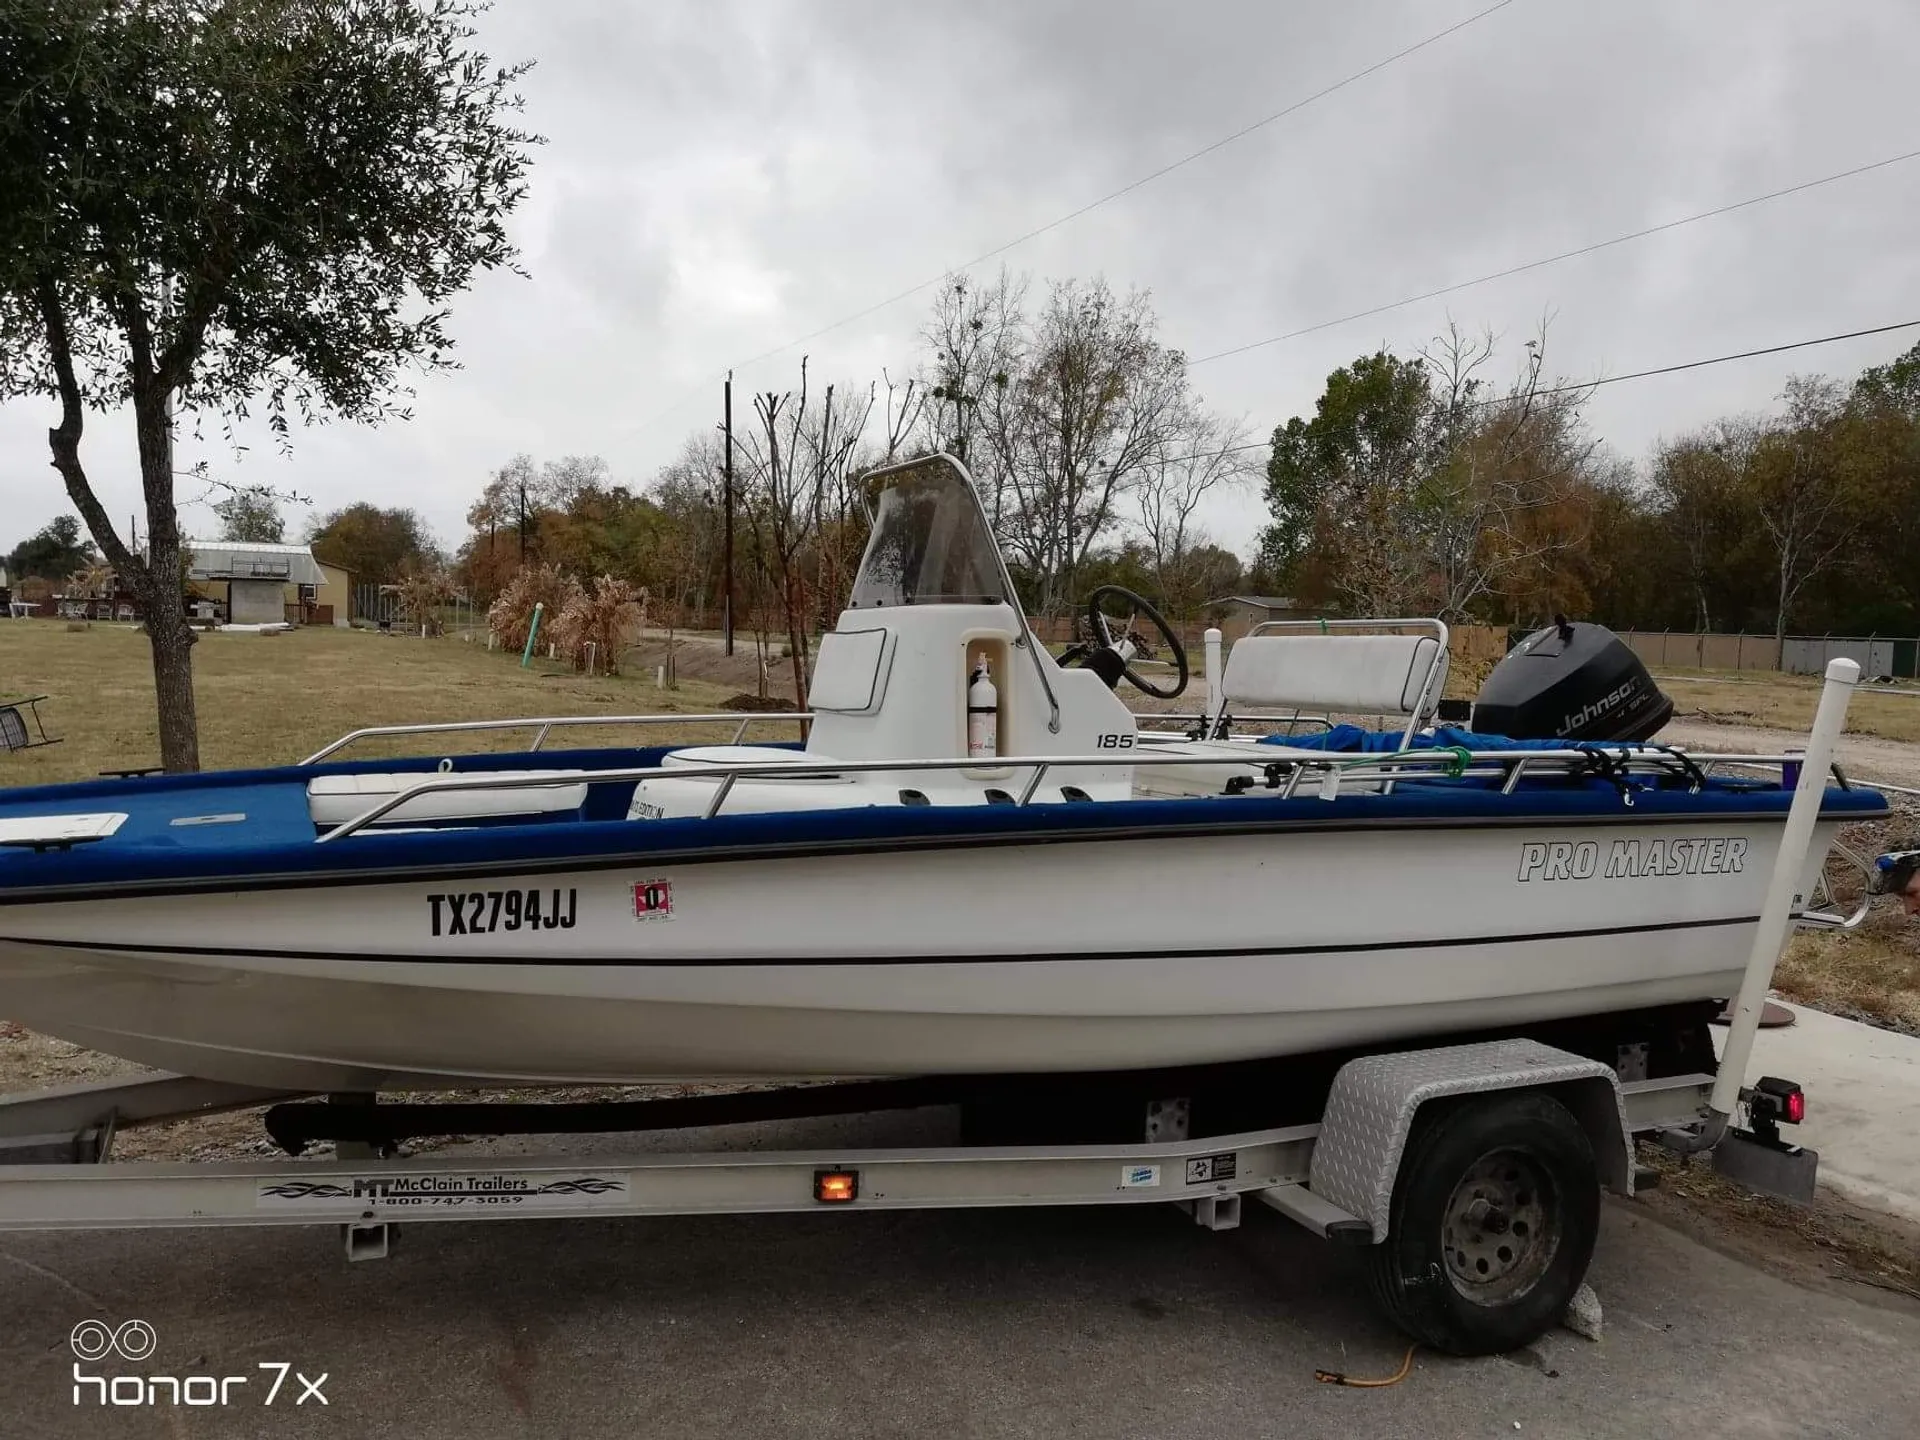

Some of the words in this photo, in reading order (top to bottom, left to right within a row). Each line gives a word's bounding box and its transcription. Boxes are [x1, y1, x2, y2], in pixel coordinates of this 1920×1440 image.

[1556, 676, 1642, 737] Johnson
[1097, 734, 1134, 749] 185
[1517, 840, 1599, 882] PRO
[1604, 836, 1749, 878] MASTER
[426, 888, 577, 937] TX2794JJ
[353, 1179, 394, 1198] MT
[394, 1177, 463, 1191] McClain
[466, 1176, 529, 1191] Trailers
